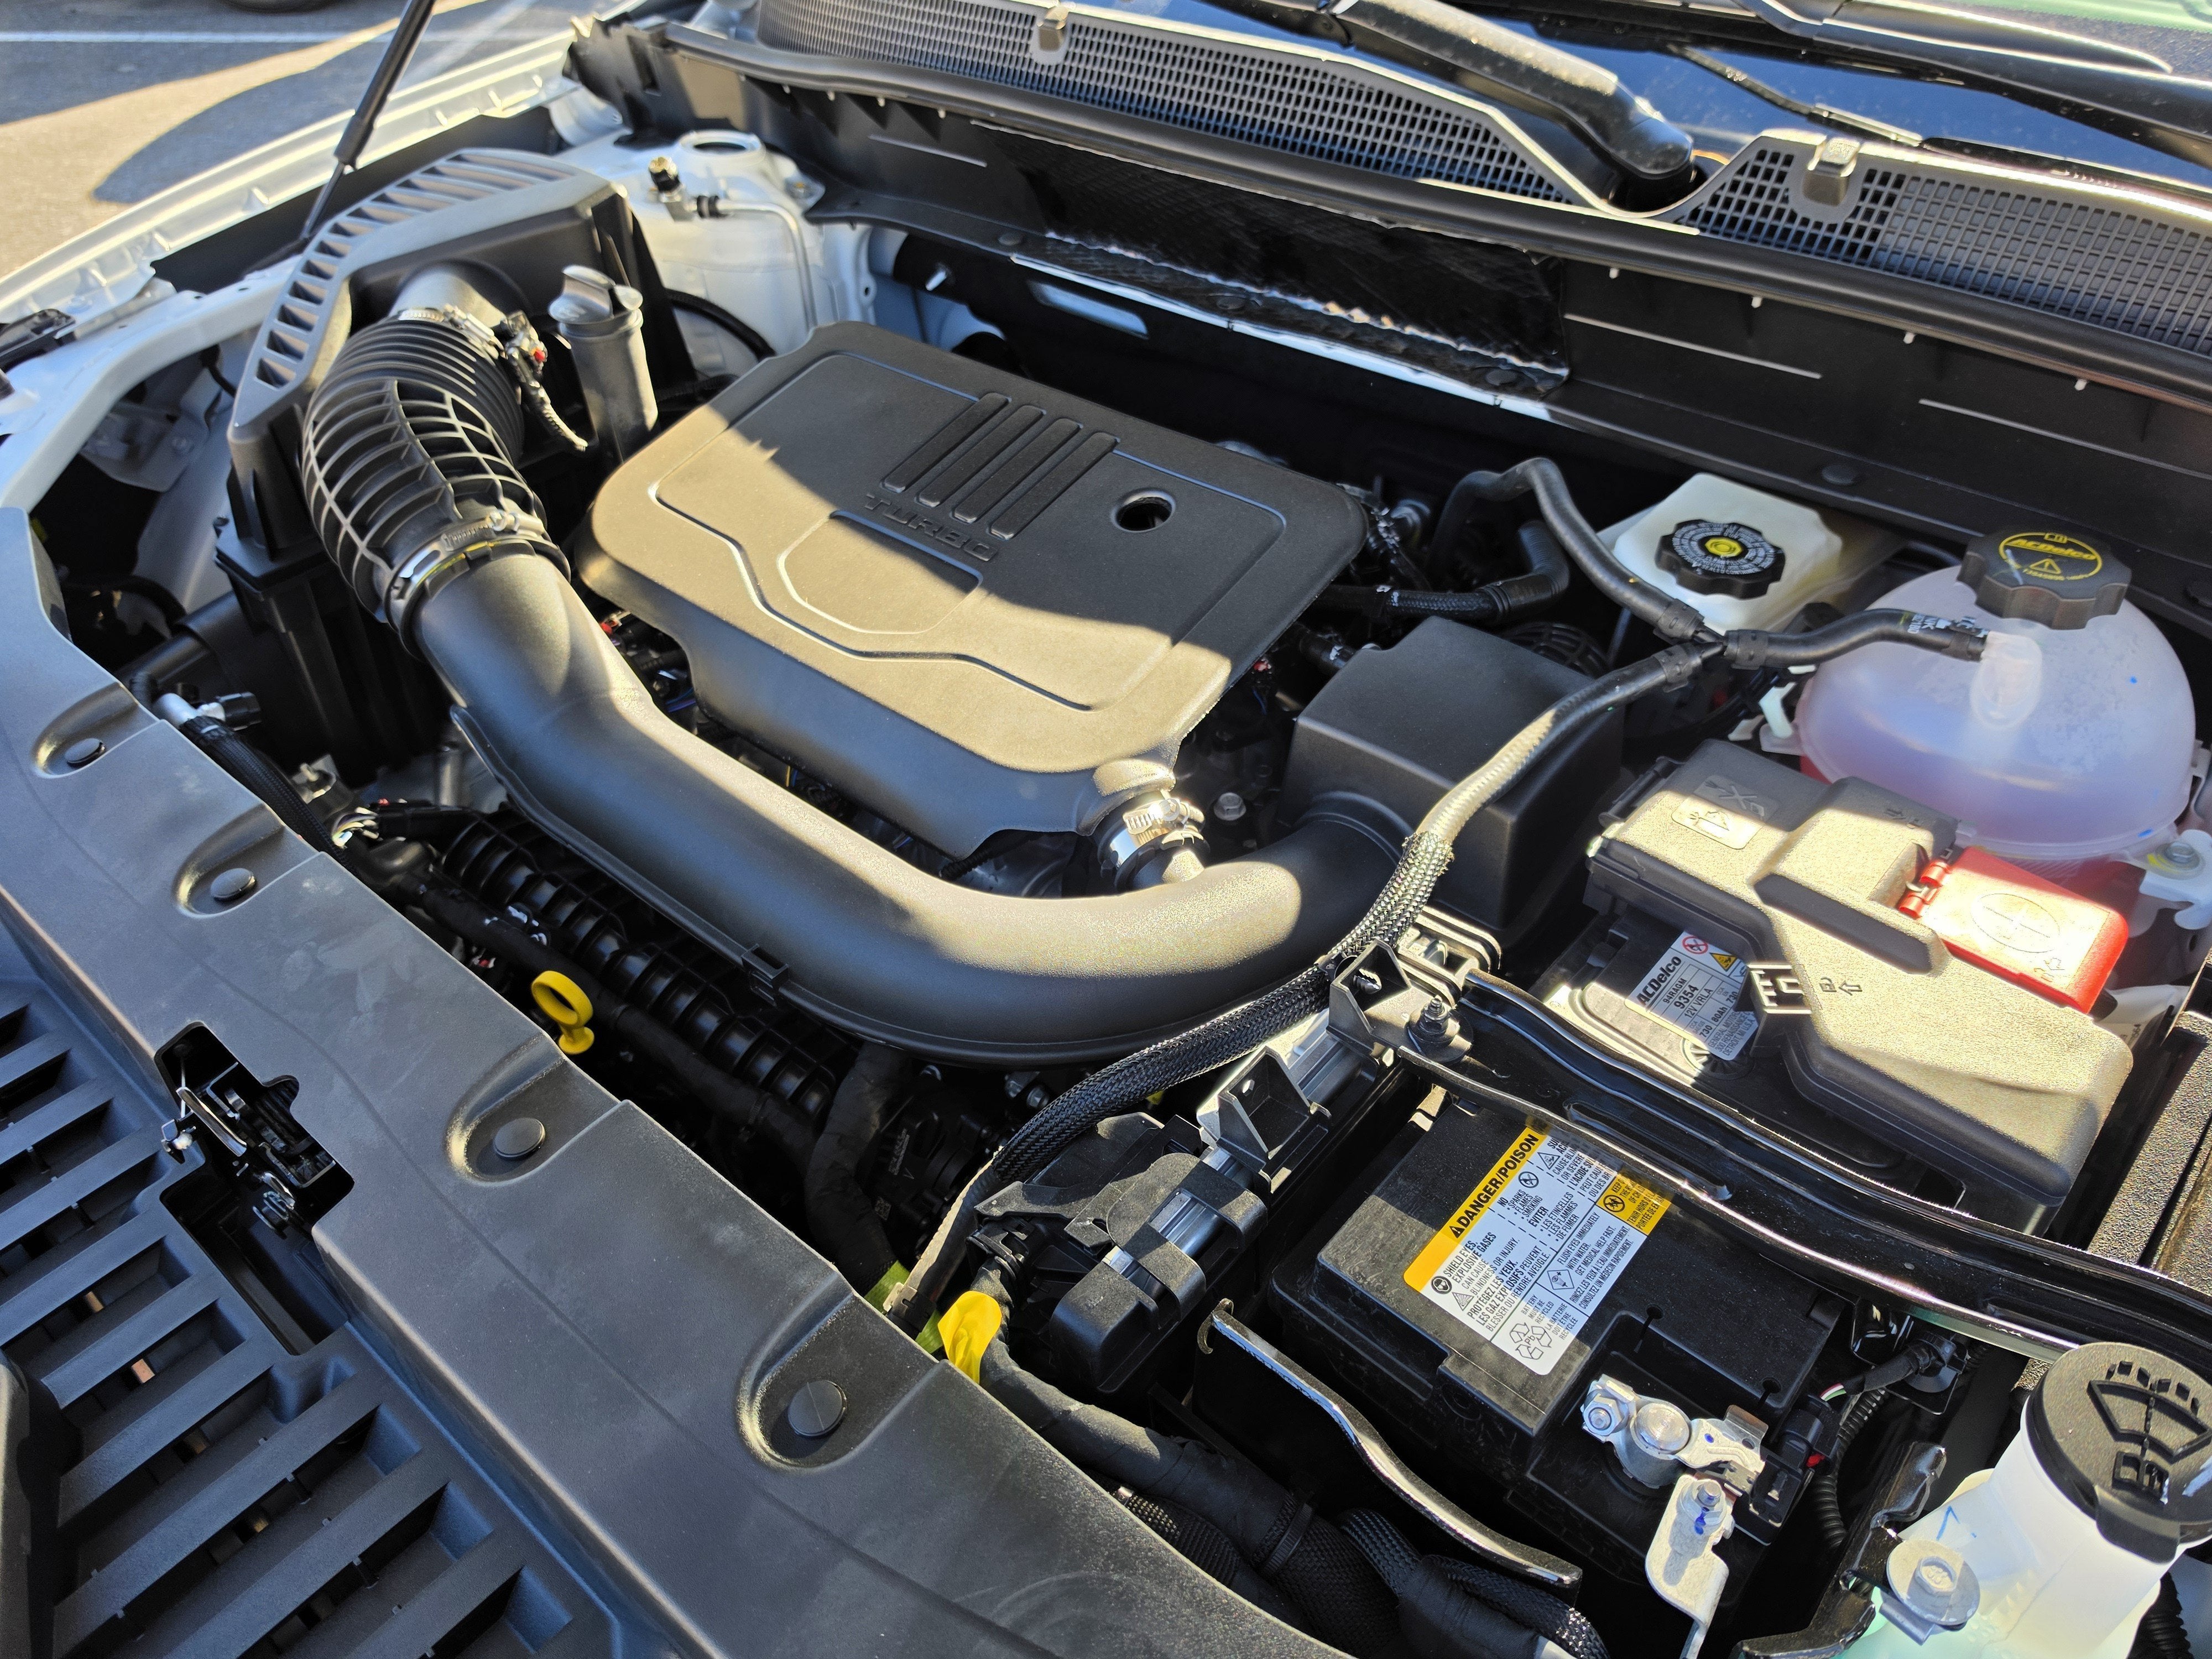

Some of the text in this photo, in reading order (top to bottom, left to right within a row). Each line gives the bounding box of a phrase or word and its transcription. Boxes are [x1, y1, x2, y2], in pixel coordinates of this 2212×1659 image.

[865, 493, 997, 561] TURBO
[1636, 956, 1682, 1005] ACDelco
[1662, 978, 1687, 1004] 94RAGM
[1673, 984, 1699, 1009] 9354
[1684, 1005, 1698, 1019] 12V
[1692, 988, 1714, 1006] VRLA
[1711, 1006, 1728, 1022] 80Ah
[1699, 1025, 1713, 1037] 730
[1707, 1027, 1728, 1048] GENERAL
[1714, 1042, 1726, 1052] 300
[1721, 1013, 1748, 1044] RENAISSANCE
[1722, 1035, 1743, 1056] DETROIT,
[1552, 1157, 1569, 1175] CAUSE
[1561, 1171, 1572, 1181] OR
[1568, 1165, 1589, 1187] L'ACIDE
[1456, 1134, 1539, 1228] DANGER/POISON
[1579, 1177, 1594, 1192] PEUT
[1588, 1187, 1599, 1197] OU
[1594, 1178, 1606, 1190] DES
[1619, 1188, 1631, 1198] THE
[1496, 1197, 1509, 1207] NO
[1507, 1189, 1526, 1208] SPARKS
[1514, 1193, 1533, 1213] FLAMES
[1521, 1195, 1543, 1218] SMOKING
[1628, 1186, 1646, 1204] OF CHLD
[1526, 1206, 1549, 1228] ÉVITER
[1540, 1192, 1574, 1230] LES ÉTINCELLES
[1548, 1201, 1578, 1235] LES FLAMMES
[1626, 1210, 1641, 1224] TENIR
[1635, 1199, 1649, 1213] HORS
[1635, 1212, 1652, 1230] PORTÉE
[1646, 1207, 1657, 1215] DE
[1556, 1214, 1580, 1240] DE FUMER
[1557, 1212, 1600, 1265] FLUSH EYES IMMEDIATELY
[1443, 1240, 1478, 1277] SHIELD EYES.
[1451, 1232, 1496, 1284] EXPLOSIVE GASES
[1566, 1243, 1592, 1270] WITH WATER.
[1574, 1225, 1616, 1276] GET MEDICAL HELP FAST.
[1461, 1258, 1489, 1289] CAN CAUSE
[1469, 1237, 1520, 1296] BLINDNESS OR INJURY.
[1569, 1286, 1585, 1303] RINCEZ
[1579, 1279, 1590, 1290] LES
[1585, 1269, 1598, 1282] YEUX
[1603, 1225, 1630, 1258] IMMÉDIATEMENT.
[1578, 1239, 1633, 1310] CONSULTEZ UN MÉDECIN RAPIDEMENT.
[1467, 1260, 1519, 1319] PROTÉGEZ LES YEUX.
[1475, 1245, 1542, 1326] LES GAZ EXPLOSIFS PEUVENT
[1485, 1252, 1551, 1332] BLESSER OU RENDRE AVEUGLE.
[1521, 1295, 1538, 1315] BATTERY
[1528, 1305, 1541, 1319] MUST
[1535, 1301, 1554, 1324] RECYCLED
[1545, 1303, 1568, 1331] LA BATTERIE
[1552, 1312, 1572, 1335] DOIT ÊTRE
[1558, 1317, 1578, 1340] RECYCLÉE
[1524, 1335, 1536, 1345] Pb
